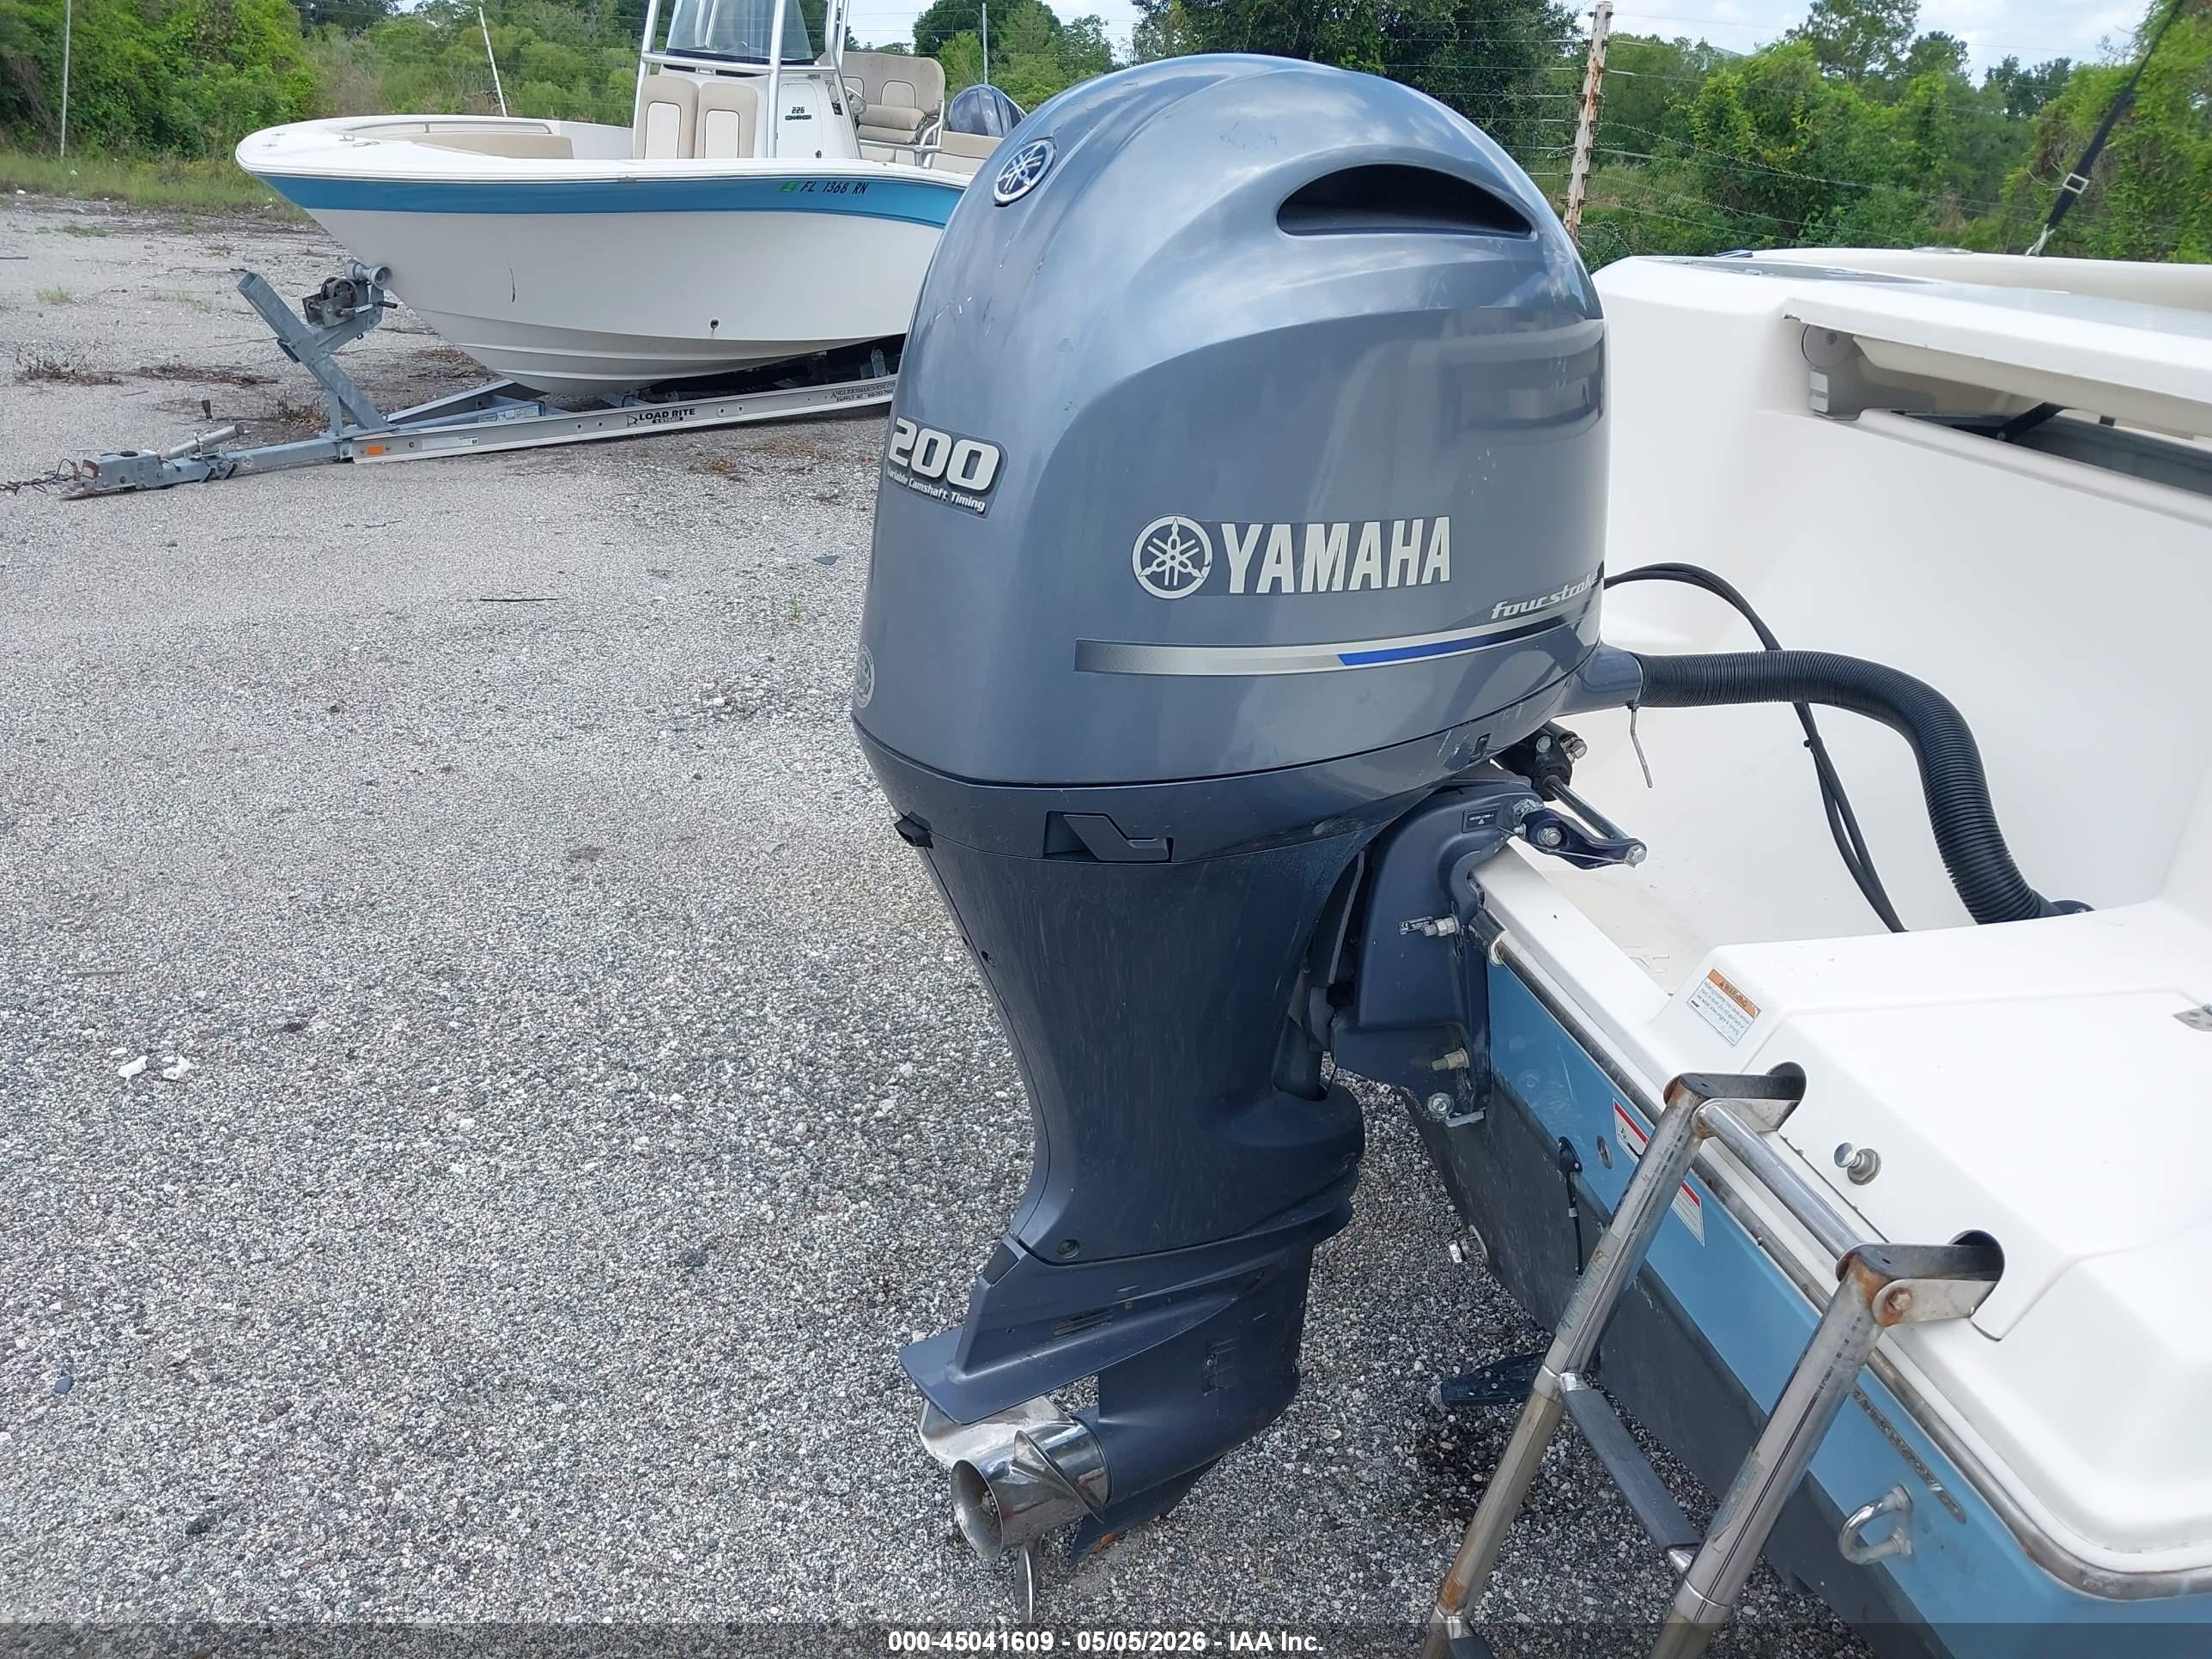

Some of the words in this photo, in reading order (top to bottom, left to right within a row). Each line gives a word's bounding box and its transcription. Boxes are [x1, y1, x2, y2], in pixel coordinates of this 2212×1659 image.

[791, 106, 805, 114] 226
[799, 180, 817, 192] FL
[823, 180, 849, 194] 1368
[852, 182, 870, 195] RN
[639, 410, 669, 422] LOAD
[672, 408, 696, 418] RITE
[888, 416, 1000, 491] 200
[908, 477, 949, 499] Camshaft
[950, 491, 986, 513] Timing
[1220, 516, 1451, 594] YAMAHA
[1723, 983, 1749, 1008] WARNING
